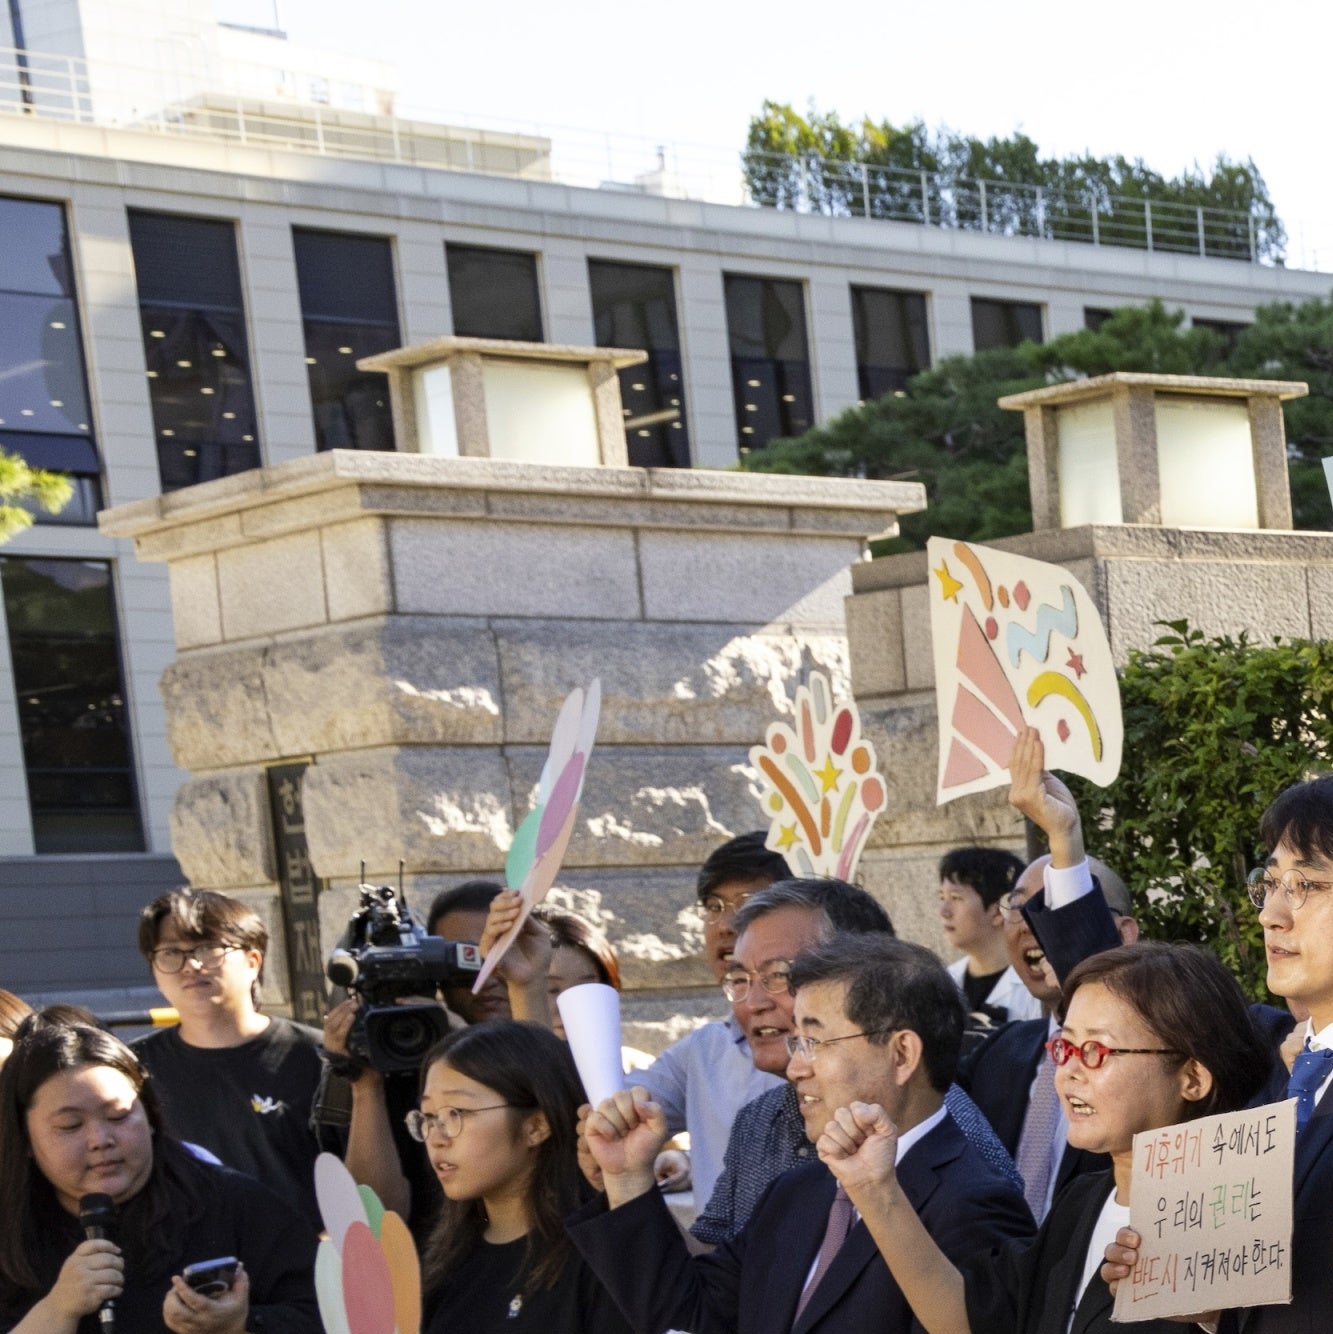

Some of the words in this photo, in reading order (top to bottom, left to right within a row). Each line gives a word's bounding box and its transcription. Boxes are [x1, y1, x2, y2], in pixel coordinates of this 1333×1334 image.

[1145, 1128, 1202, 1179] 기후위기
[1212, 1116, 1276, 1165] 속에서도
[1154, 1191, 1204, 1238] 우리의
[1209, 1178, 1261, 1229] 권리는
[1132, 1254, 1177, 1303] 반드시
[1184, 1246, 1248, 1291] 지켜져야
[1252, 1239, 1284, 1275] 한다.
